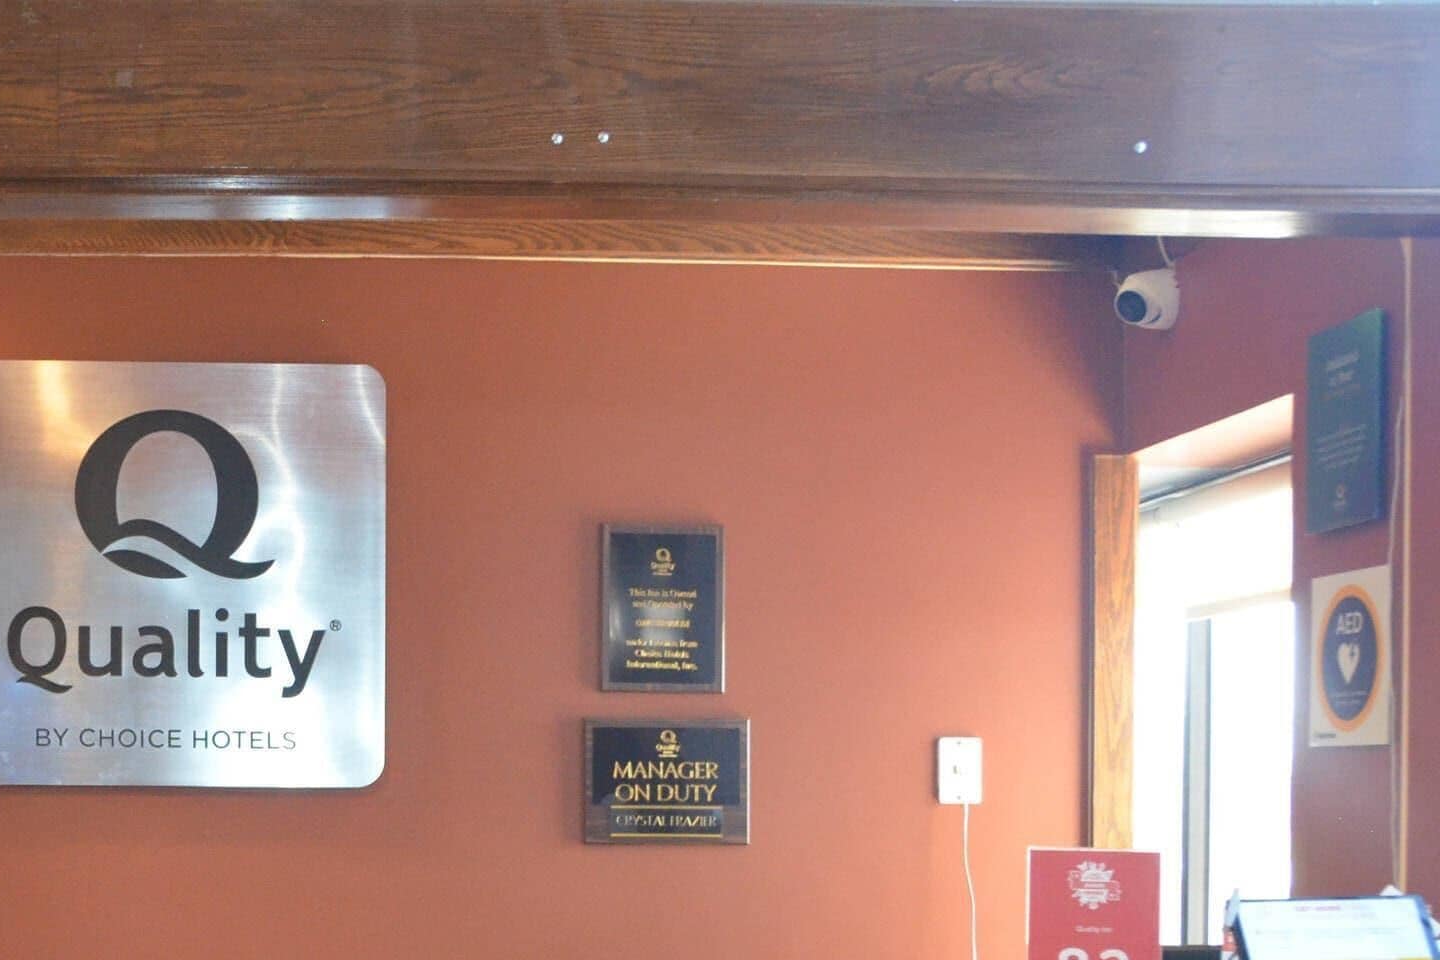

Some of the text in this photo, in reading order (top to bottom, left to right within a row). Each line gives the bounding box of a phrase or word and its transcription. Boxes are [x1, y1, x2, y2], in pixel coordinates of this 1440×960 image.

[1335, 612, 1365, 635] AED
[35, 728, 297, 750] BY CHOICE HOTELS
[612, 761, 719, 780] MANAGER
[615, 784, 717, 802] ON DUTY
